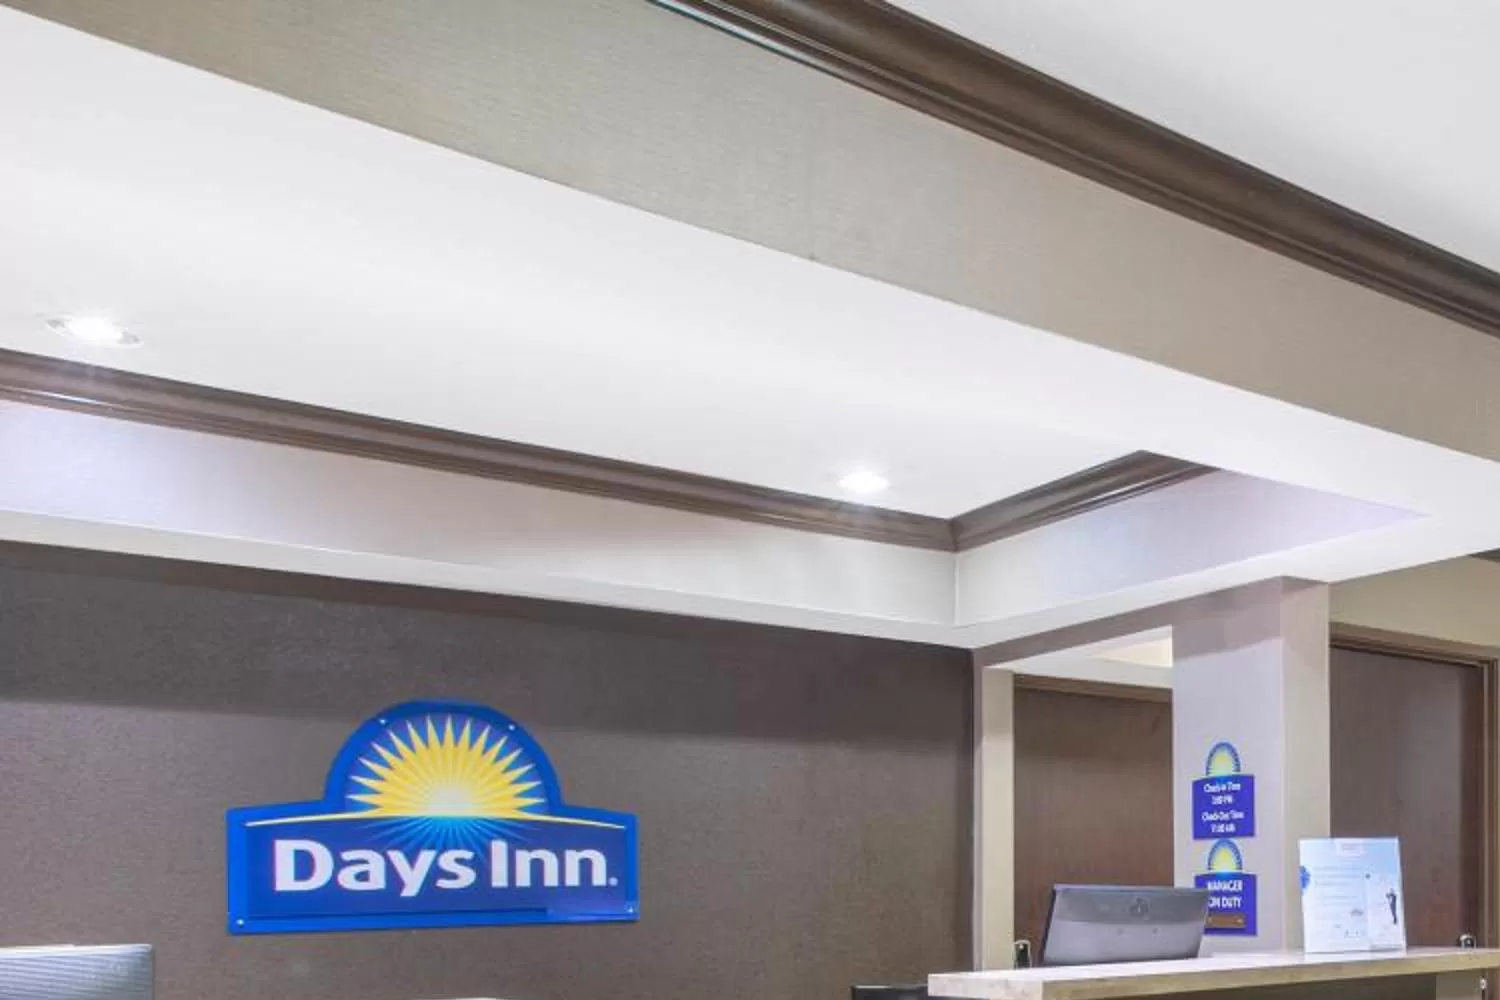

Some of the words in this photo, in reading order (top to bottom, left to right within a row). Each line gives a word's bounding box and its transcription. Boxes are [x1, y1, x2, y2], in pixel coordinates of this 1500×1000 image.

[274, 839, 477, 898] Days
[1207, 880, 1243, 891] MANAGER
[1221, 895, 1242, 908] DUTY
